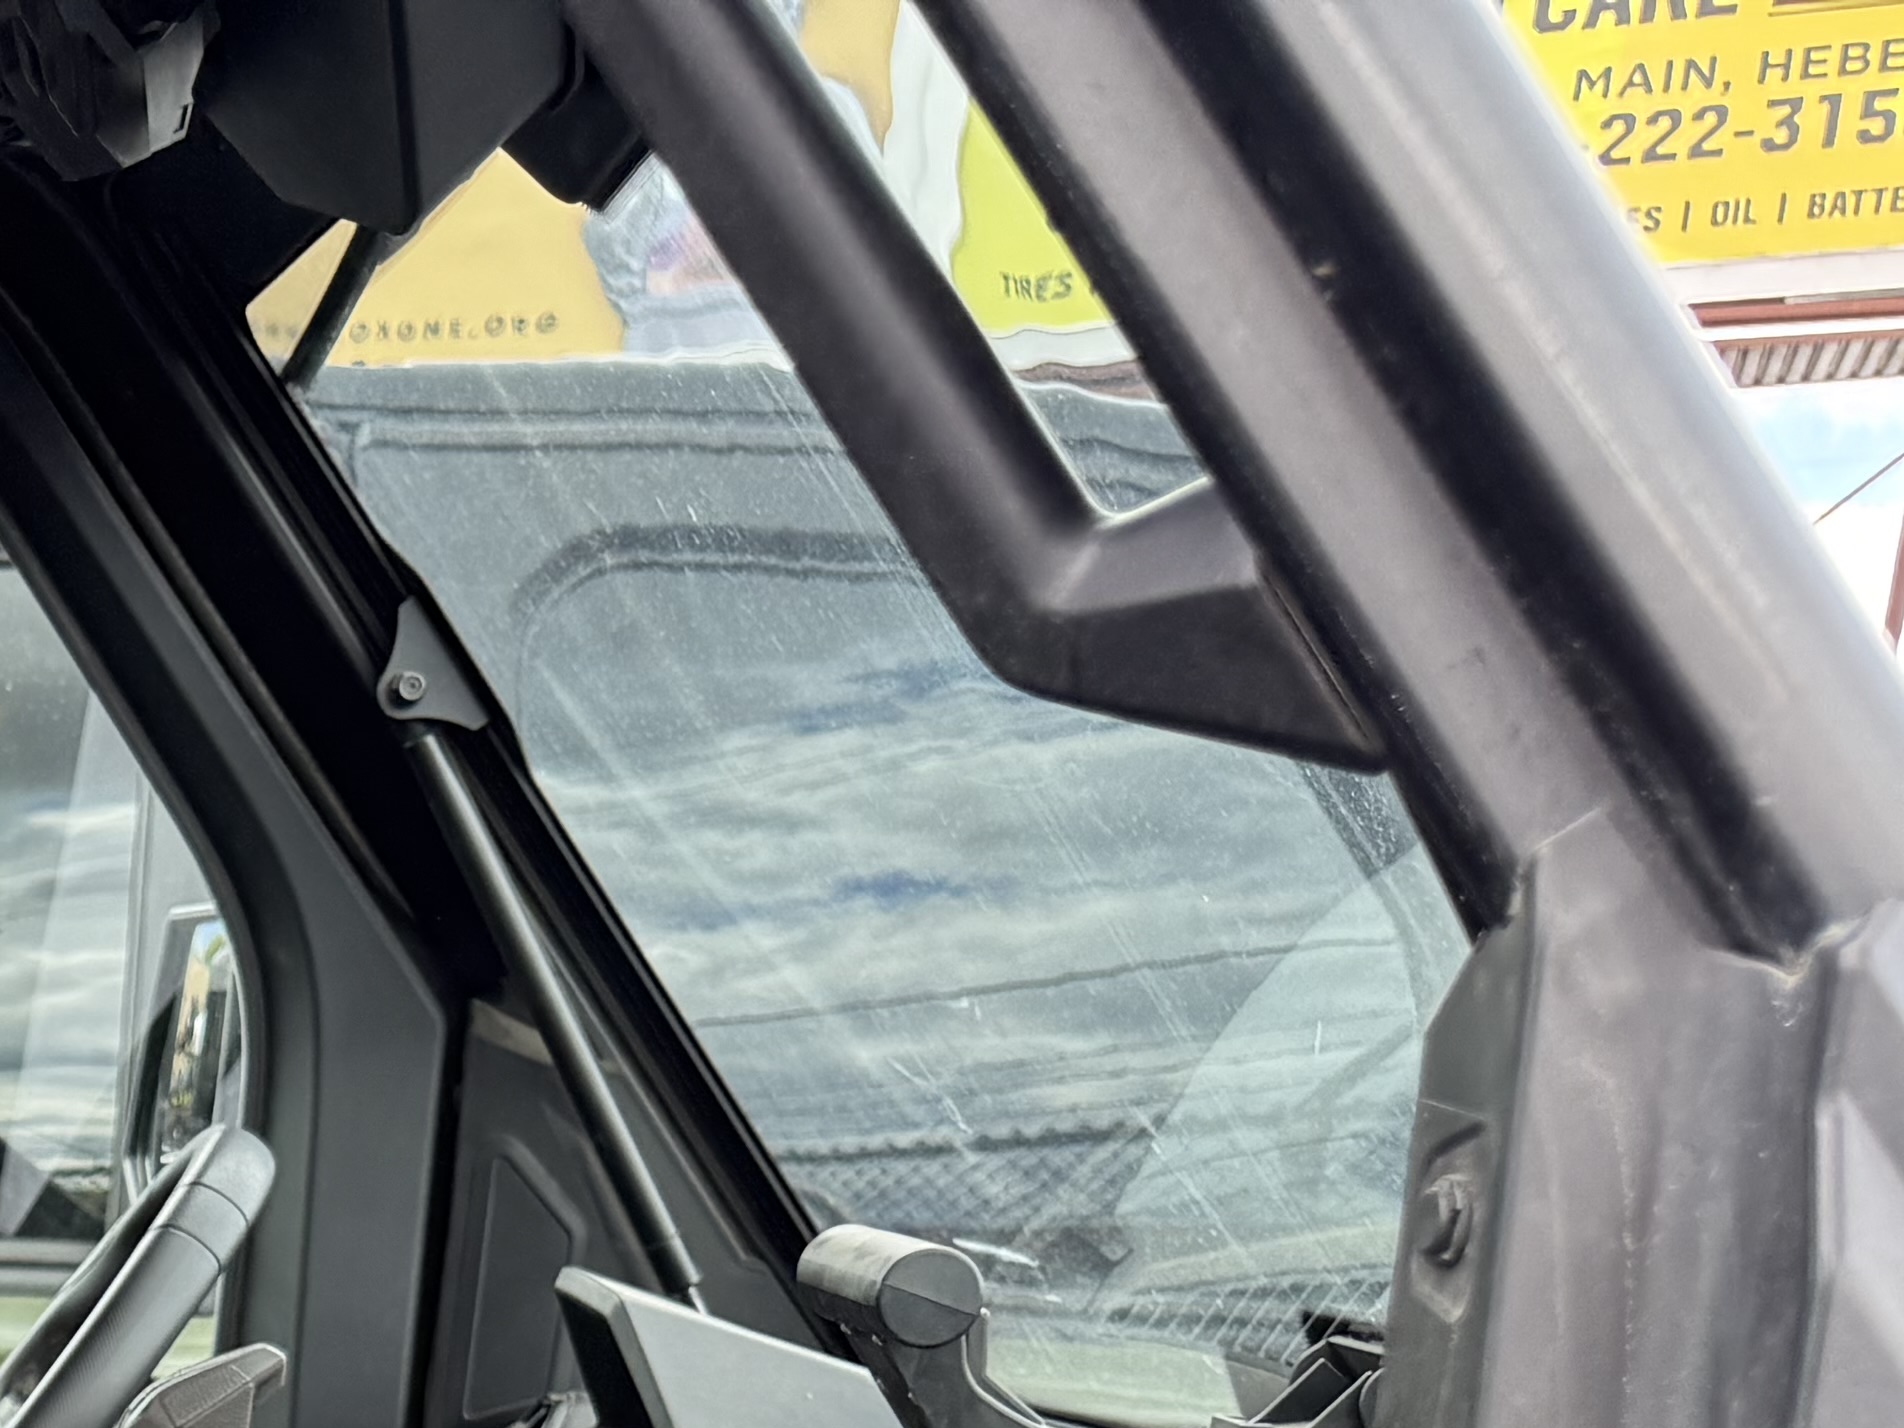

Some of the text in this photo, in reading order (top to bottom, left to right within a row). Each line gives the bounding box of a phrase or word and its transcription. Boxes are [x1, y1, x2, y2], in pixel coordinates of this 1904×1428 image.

[1572, 55, 1732, 102] MAIN,
[1710, 198, 1757, 227] OIL
[999, 270, 1073, 303] TIRES
